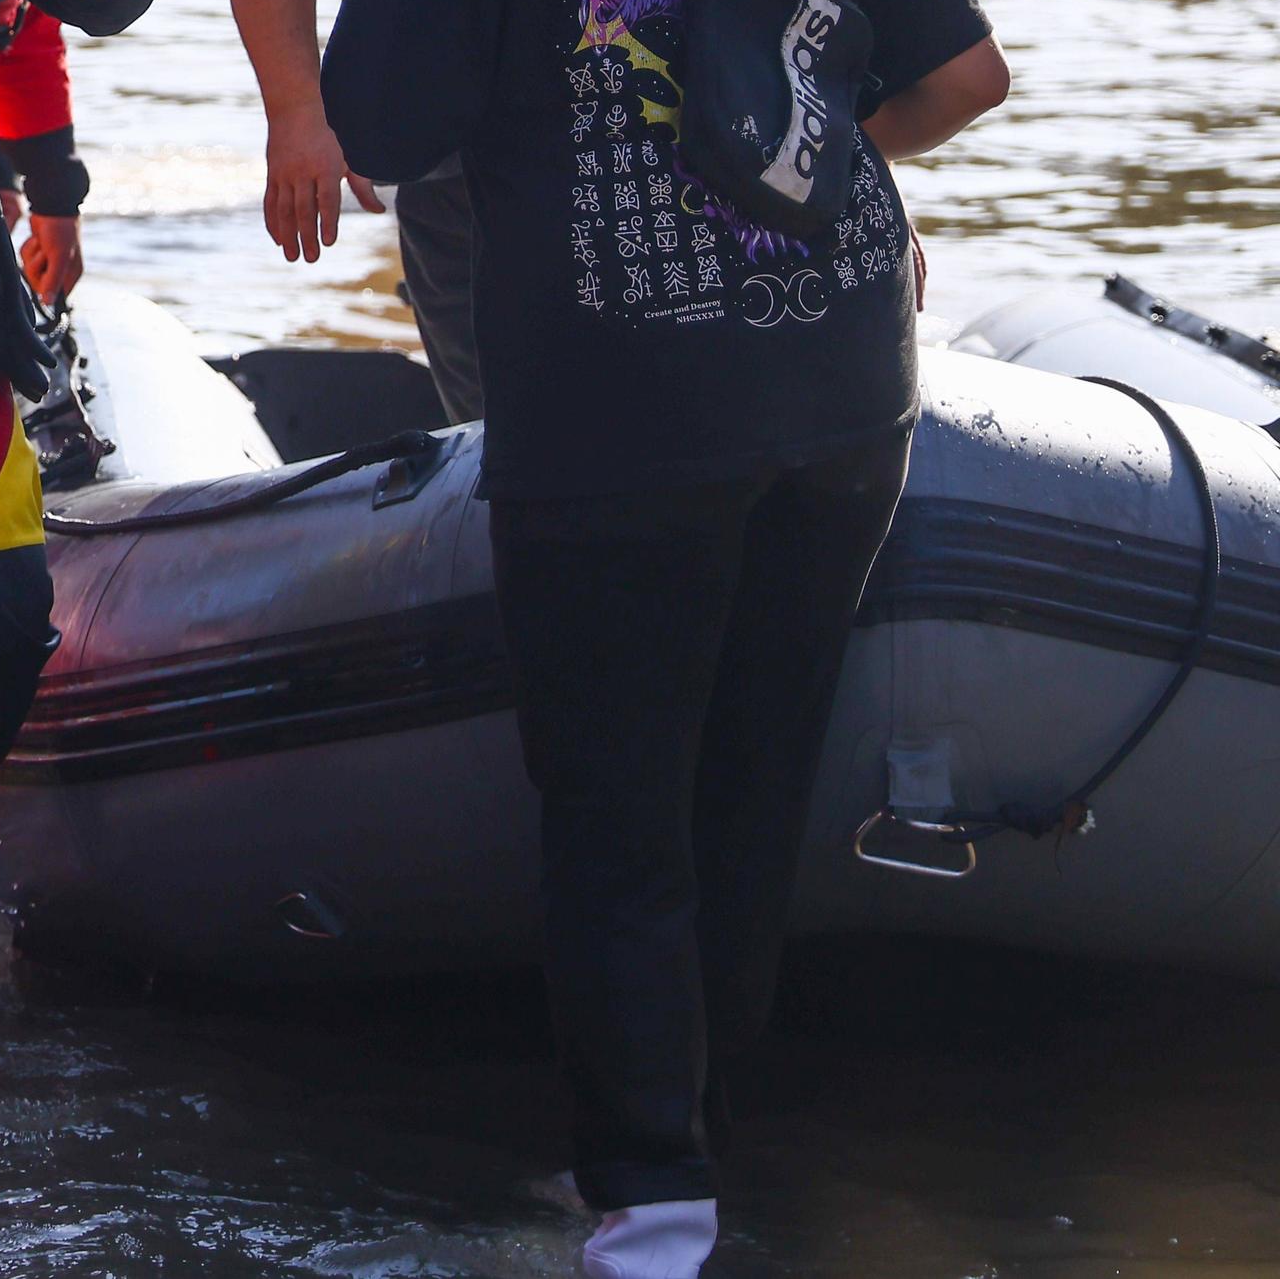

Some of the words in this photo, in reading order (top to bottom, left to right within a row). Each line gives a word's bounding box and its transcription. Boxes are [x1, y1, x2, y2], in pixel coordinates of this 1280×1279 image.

[644, 309, 673, 319] Create
[674, 305, 690, 314] and
[690, 299, 721, 311] Destroy
